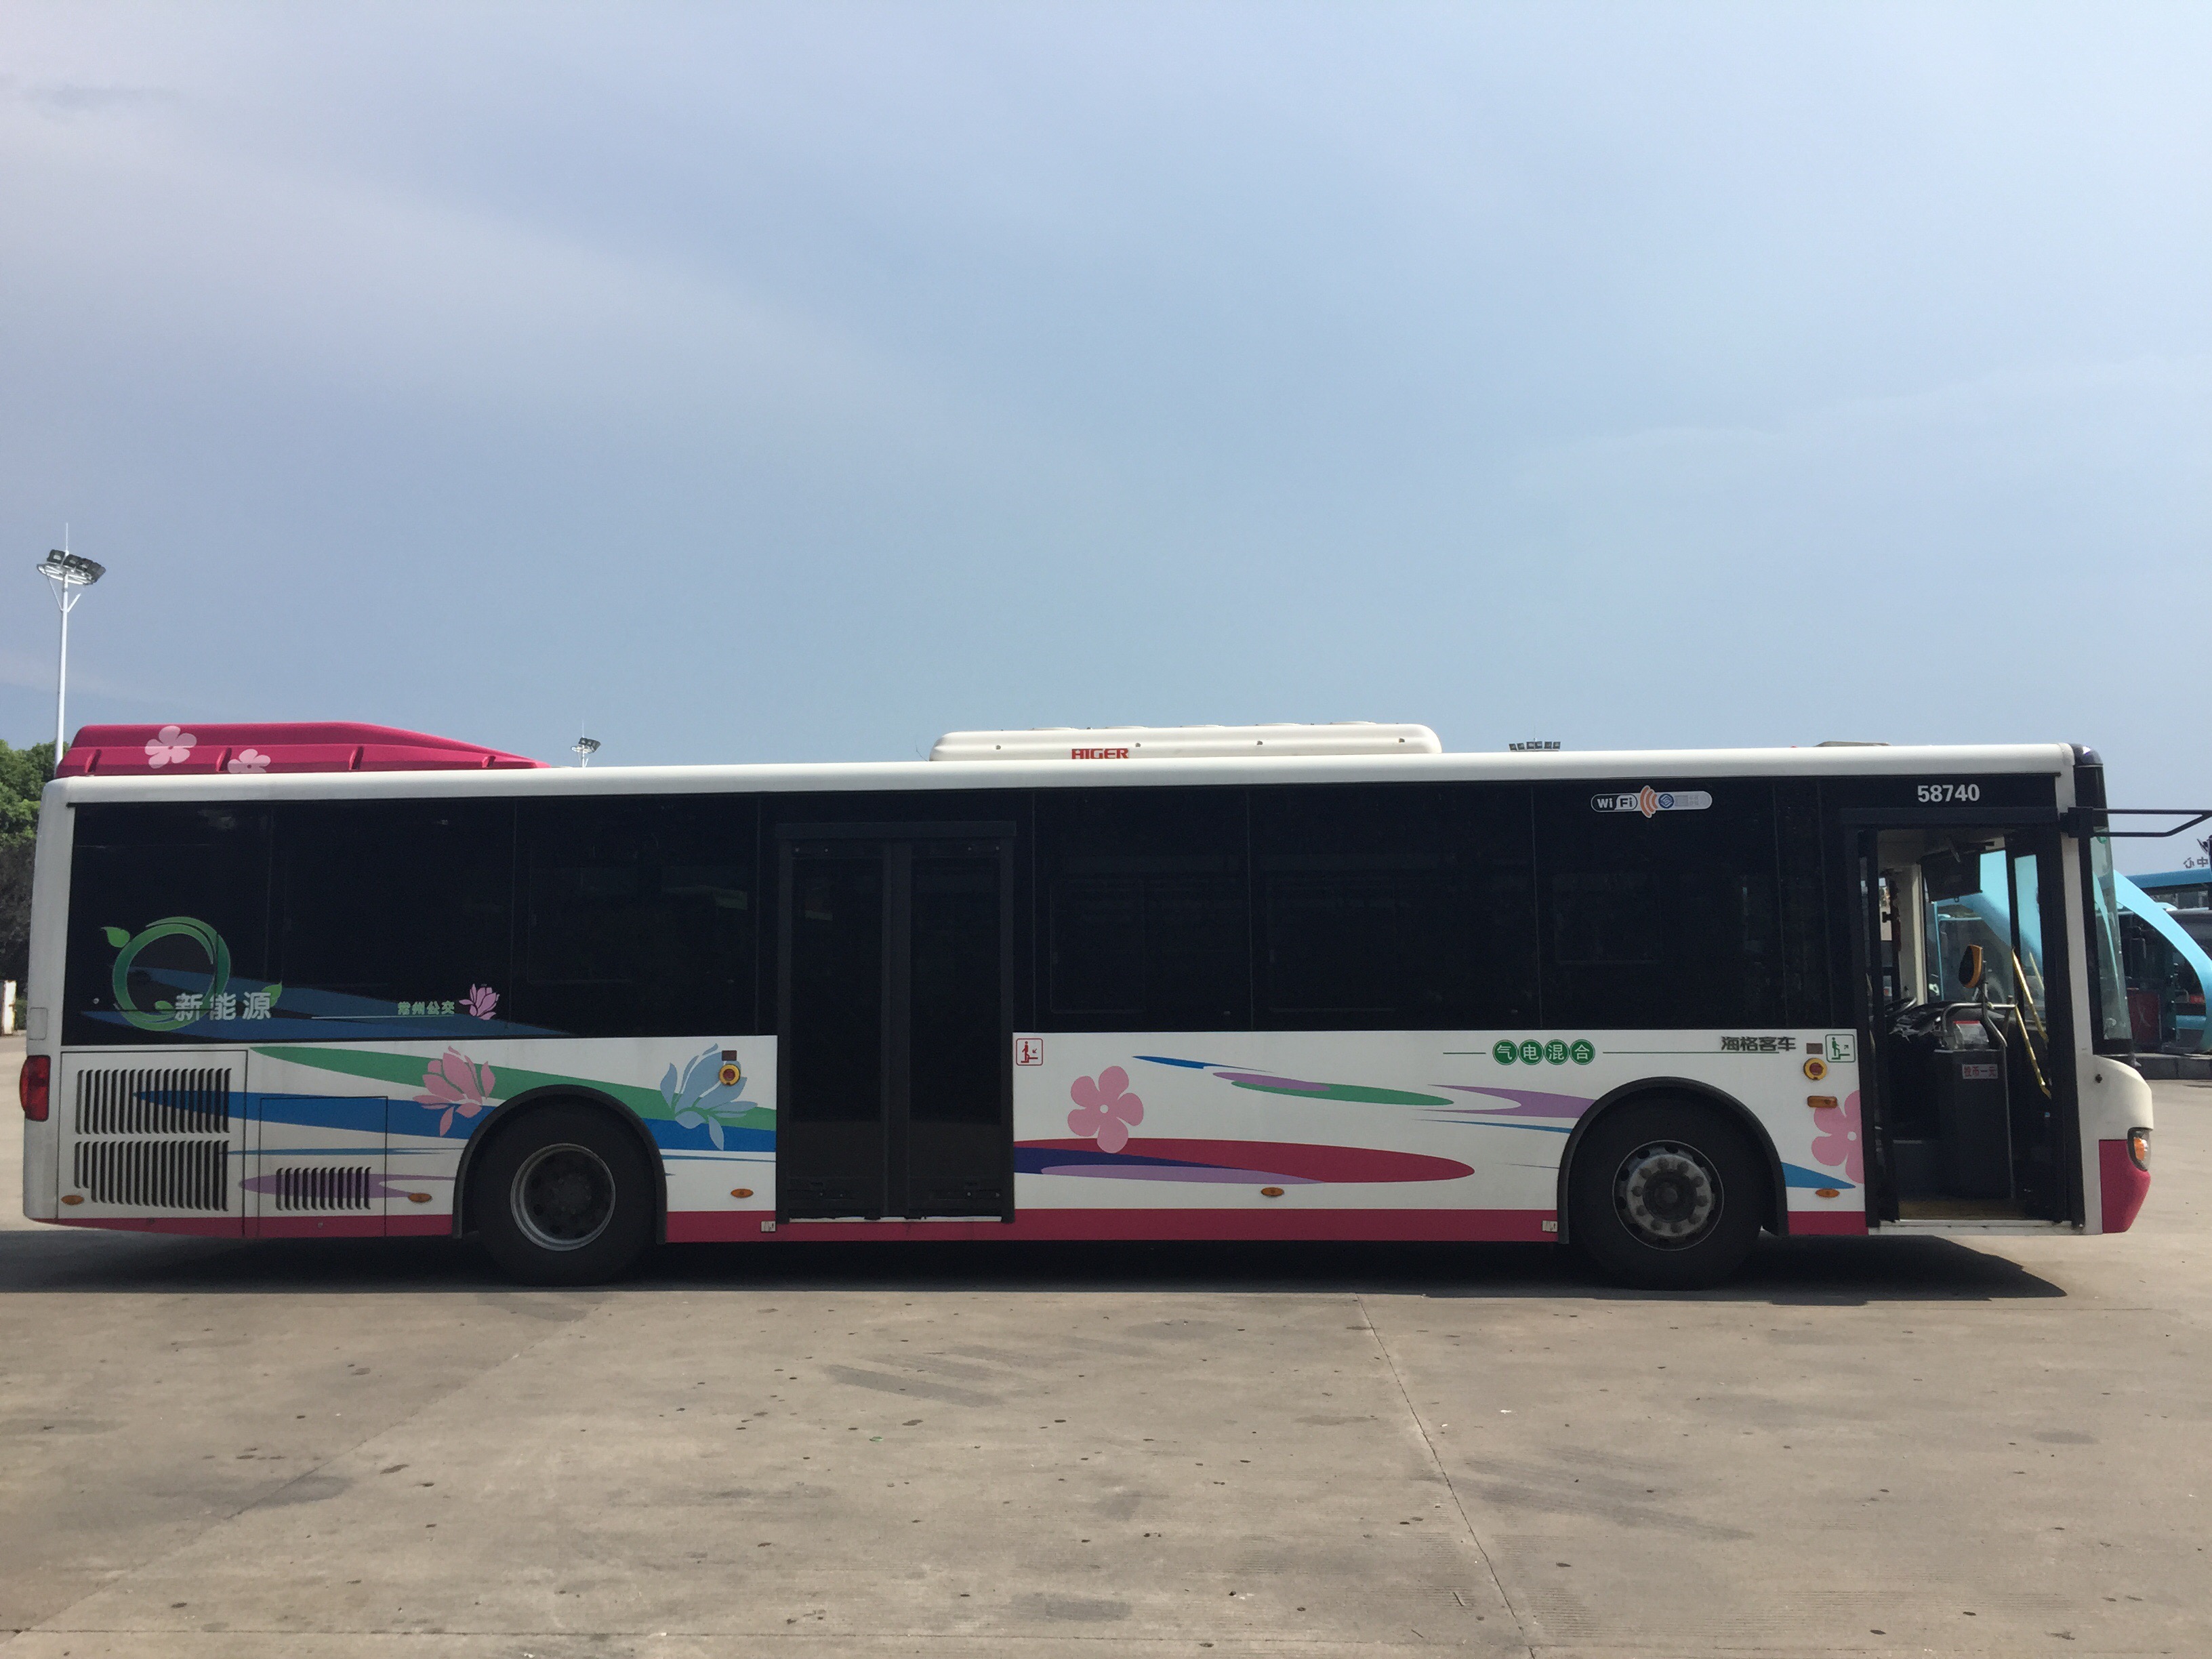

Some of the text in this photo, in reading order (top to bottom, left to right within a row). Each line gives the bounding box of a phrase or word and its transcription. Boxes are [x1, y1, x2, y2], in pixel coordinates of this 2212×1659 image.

[1071, 748, 1128, 759] HIGER
[1917, 784, 1980, 802] 58740
[175, 991, 271, 1021] 新能源
[398, 1000, 455, 1015] 常州公交
[1721, 1036, 1796, 1051] 海格客车
[1497, 1044, 1590, 1061] 气电混合
